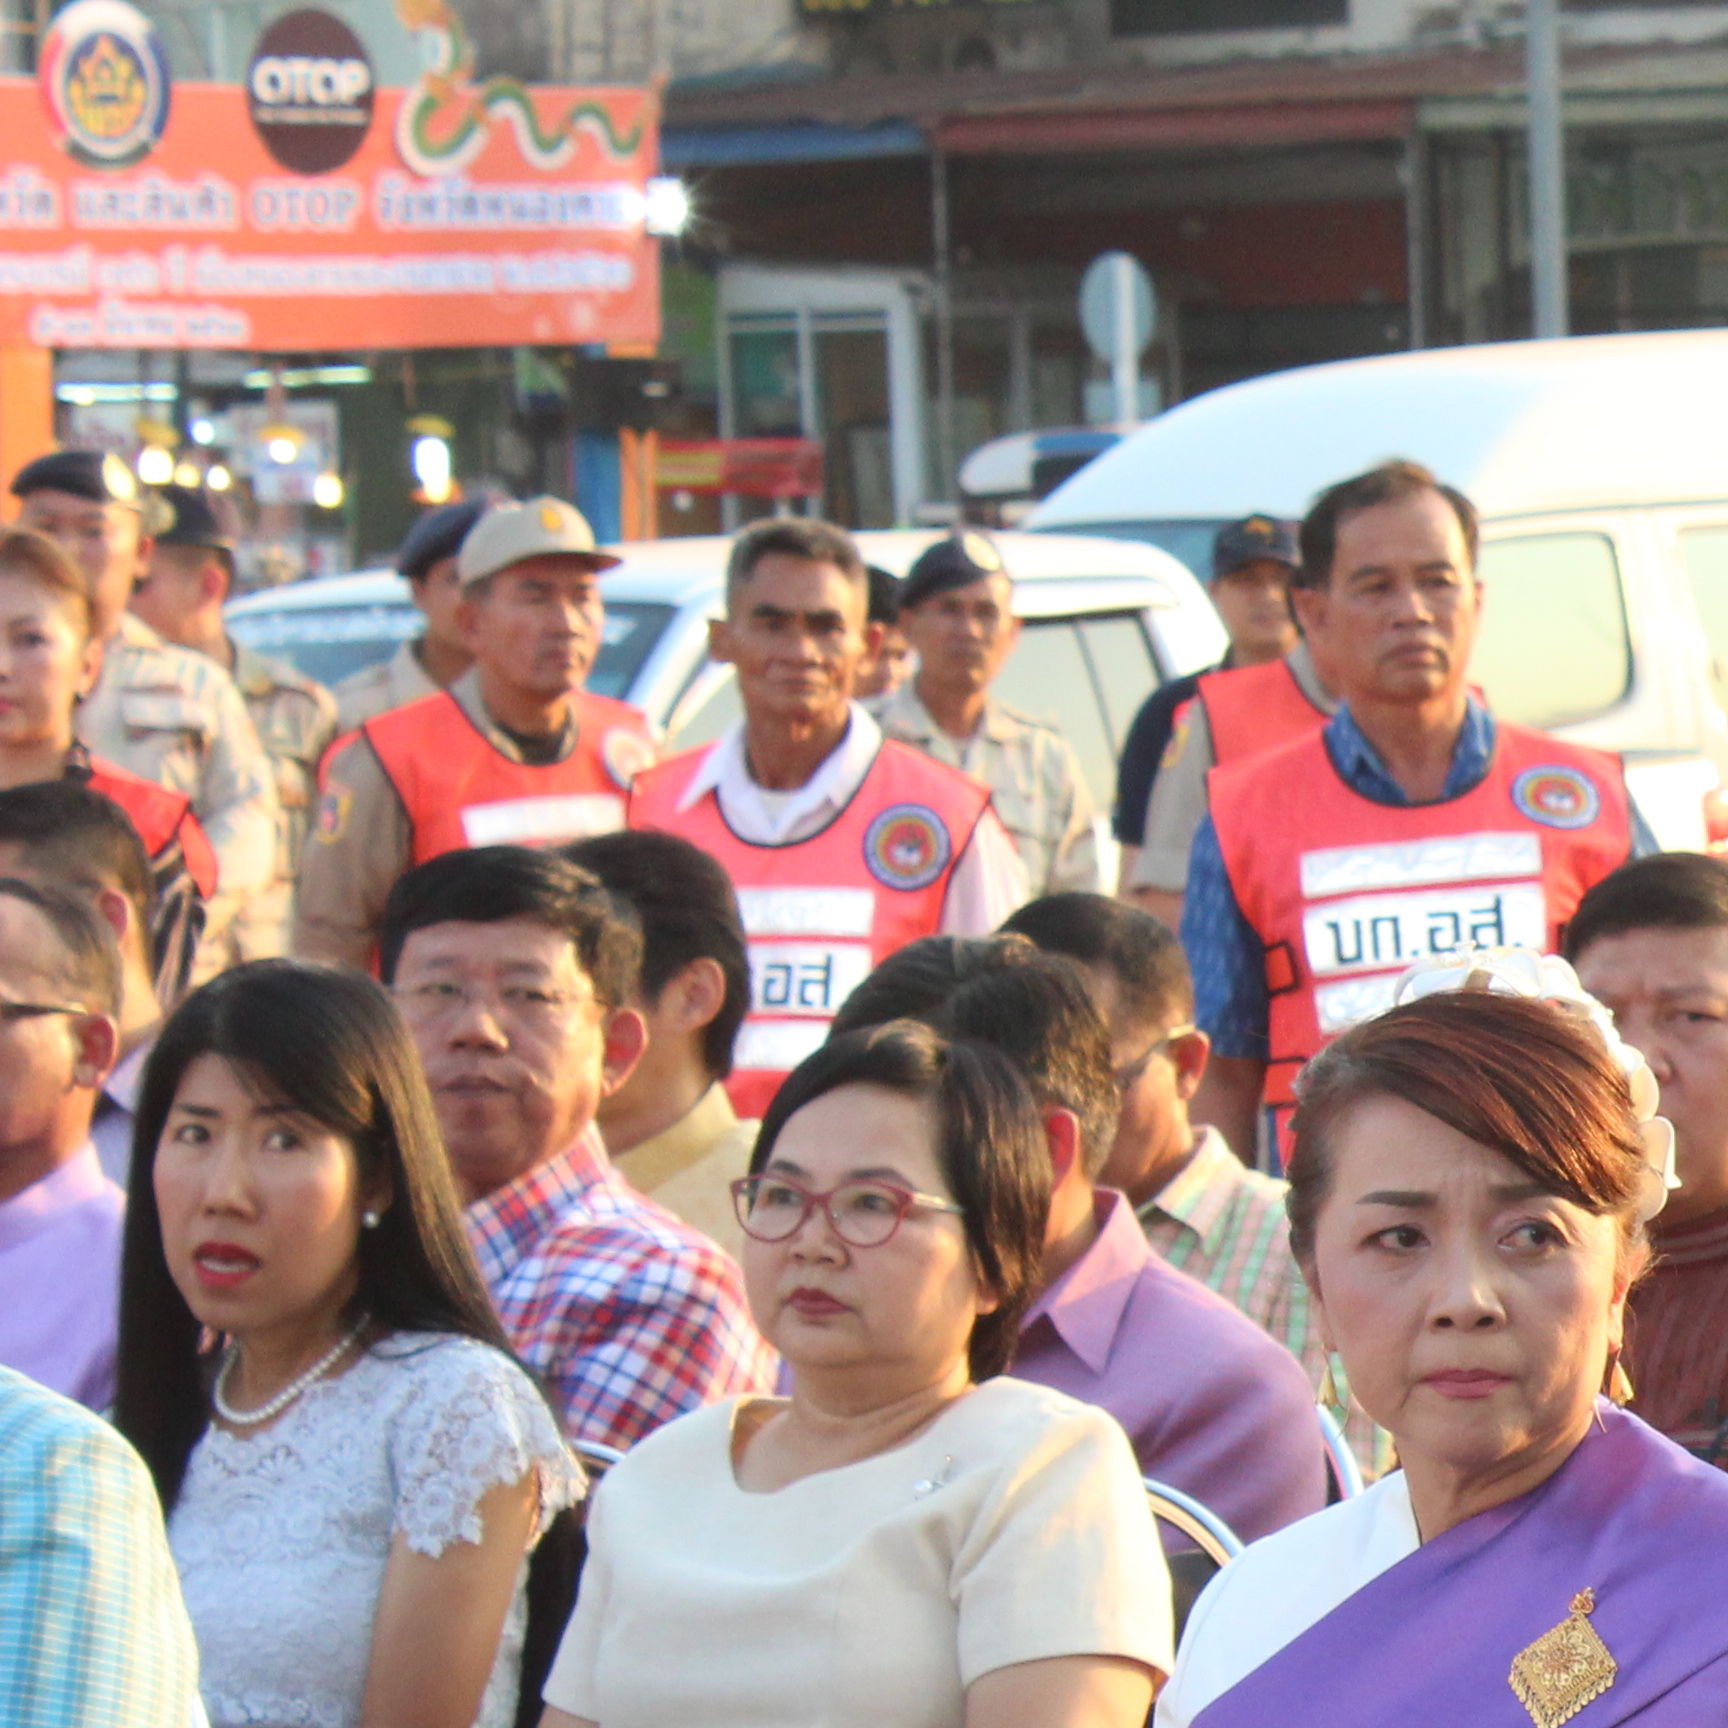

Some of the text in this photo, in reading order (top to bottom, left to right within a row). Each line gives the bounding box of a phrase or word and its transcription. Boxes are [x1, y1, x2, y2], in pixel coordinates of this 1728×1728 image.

[253, 56, 371, 104] OTOP
[252, 186, 359, 224] OTOP
[1325, 894, 1524, 966] บก.อส.
[762, 953, 833, 1007] อส
